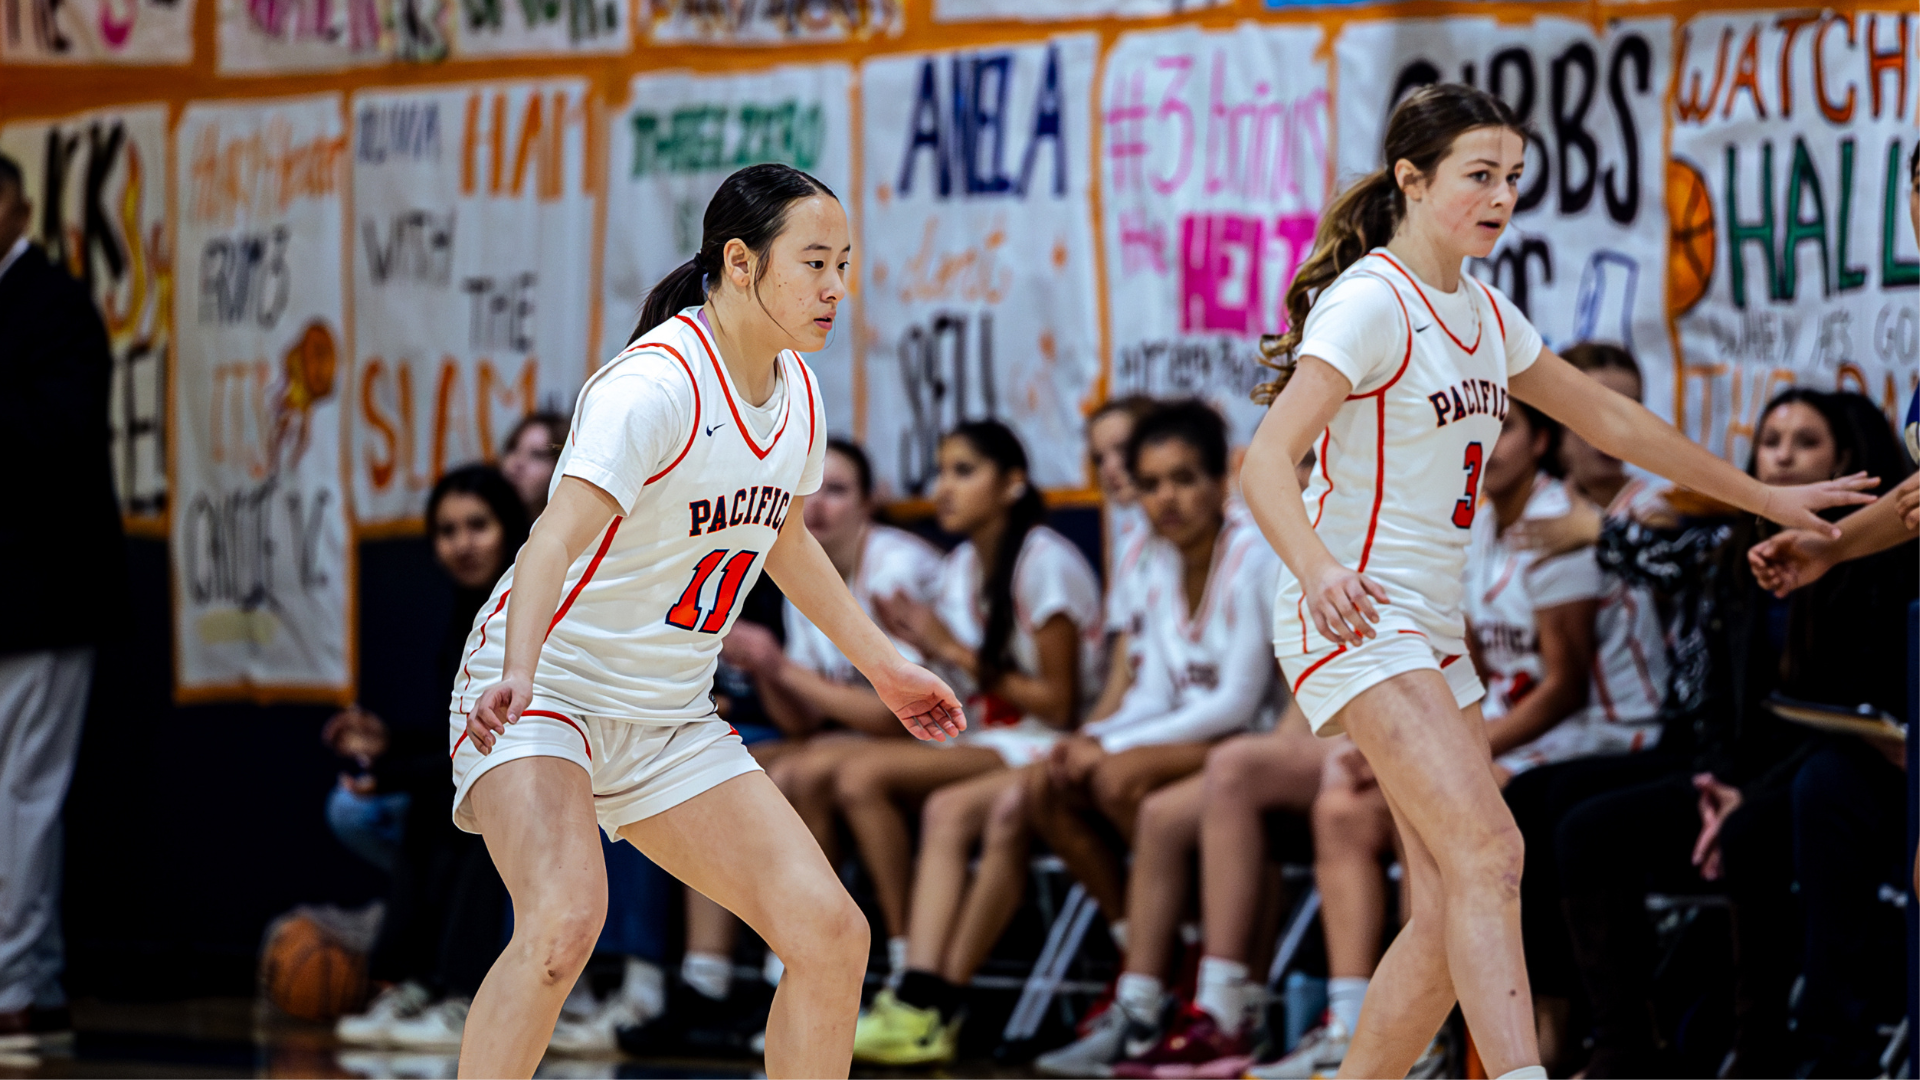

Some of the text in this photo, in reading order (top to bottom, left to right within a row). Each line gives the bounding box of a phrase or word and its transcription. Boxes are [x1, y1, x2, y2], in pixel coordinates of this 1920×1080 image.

[1674, 14, 1909, 125] WATCH
[1386, 34, 1654, 227] BBS
[1723, 137, 1919, 310] HALL
[688, 485, 791, 538] PACIFIC
[1451, 441, 1483, 530] 3
[664, 548, 759, 634] 11
